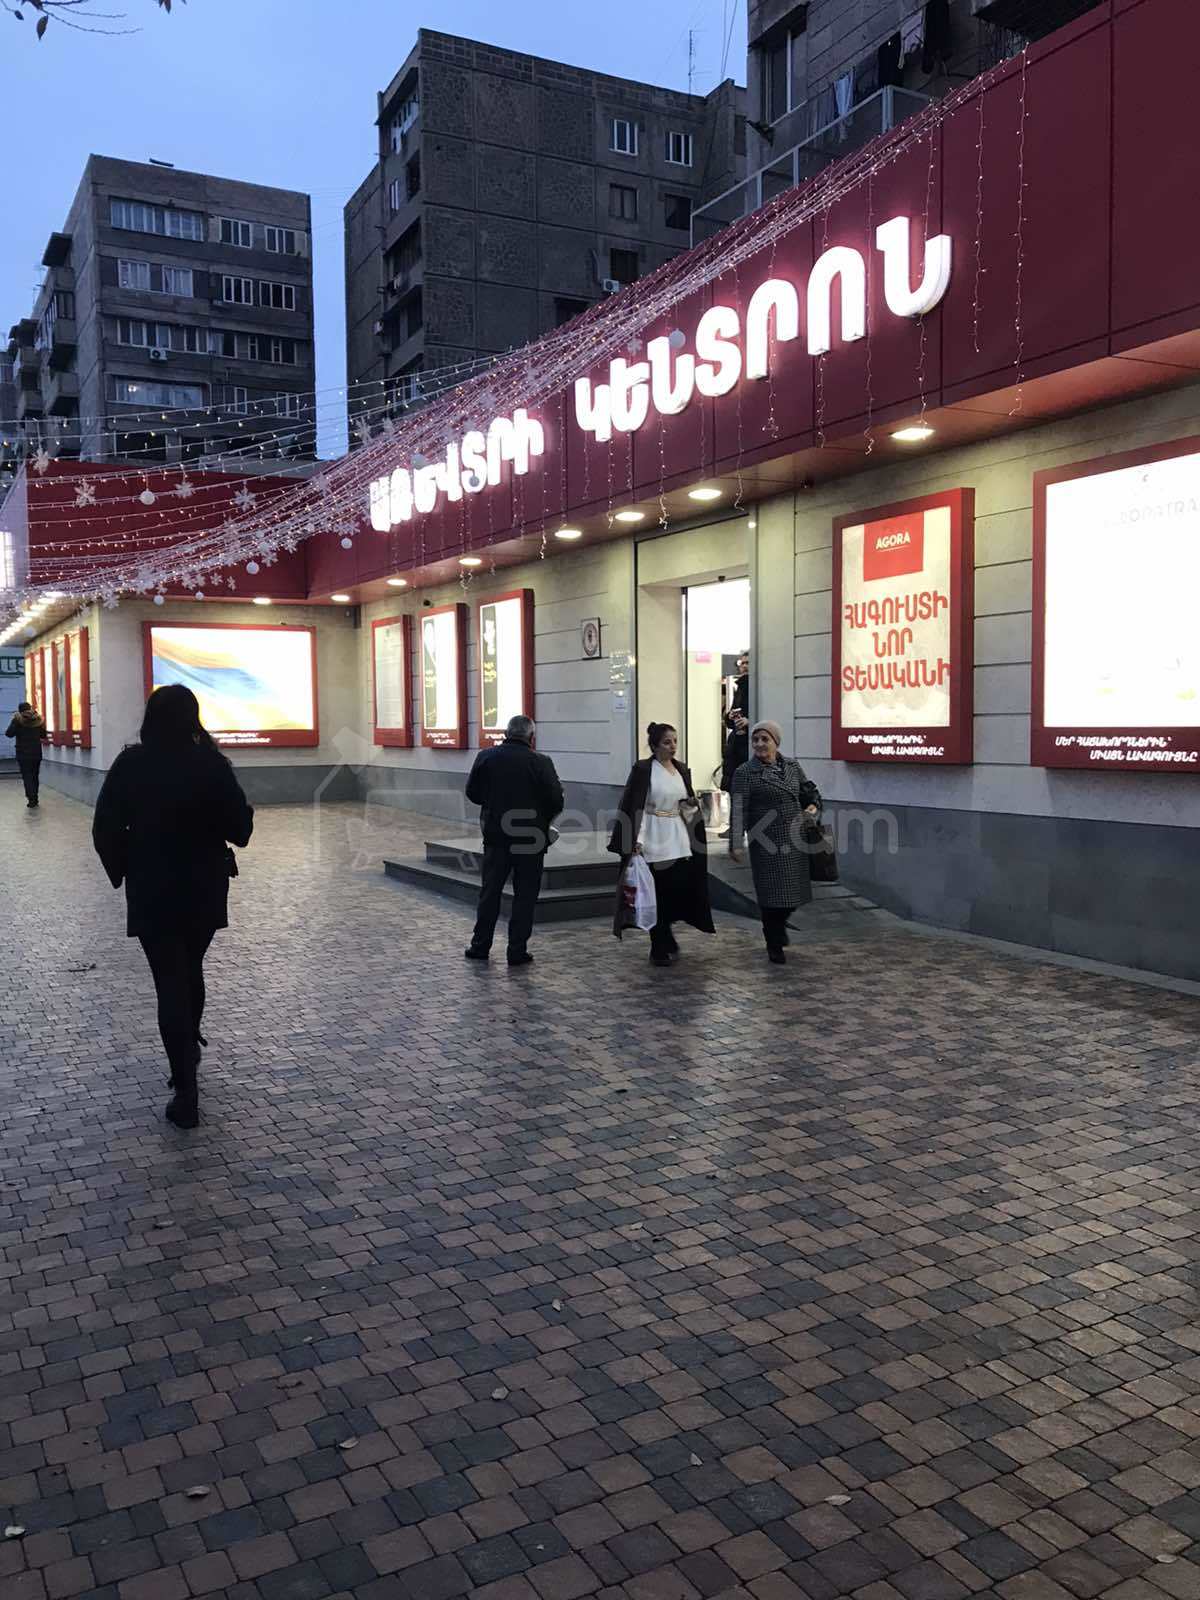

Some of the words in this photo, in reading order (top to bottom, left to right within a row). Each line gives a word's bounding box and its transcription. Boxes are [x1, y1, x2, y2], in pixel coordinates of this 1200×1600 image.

[575, 216, 953, 441] ԿԵՆՏՐՈՆ
[875, 531, 911, 550] AGORA
[844, 590, 949, 629] ՀԱԳՈՒՍՏԻ
[872, 627, 913, 658] ՆՈՐ
[842, 658, 951, 692] ՏԵՍԱԿԱՆԻ
[1055, 736, 1075, 746] ՄԵՐ
